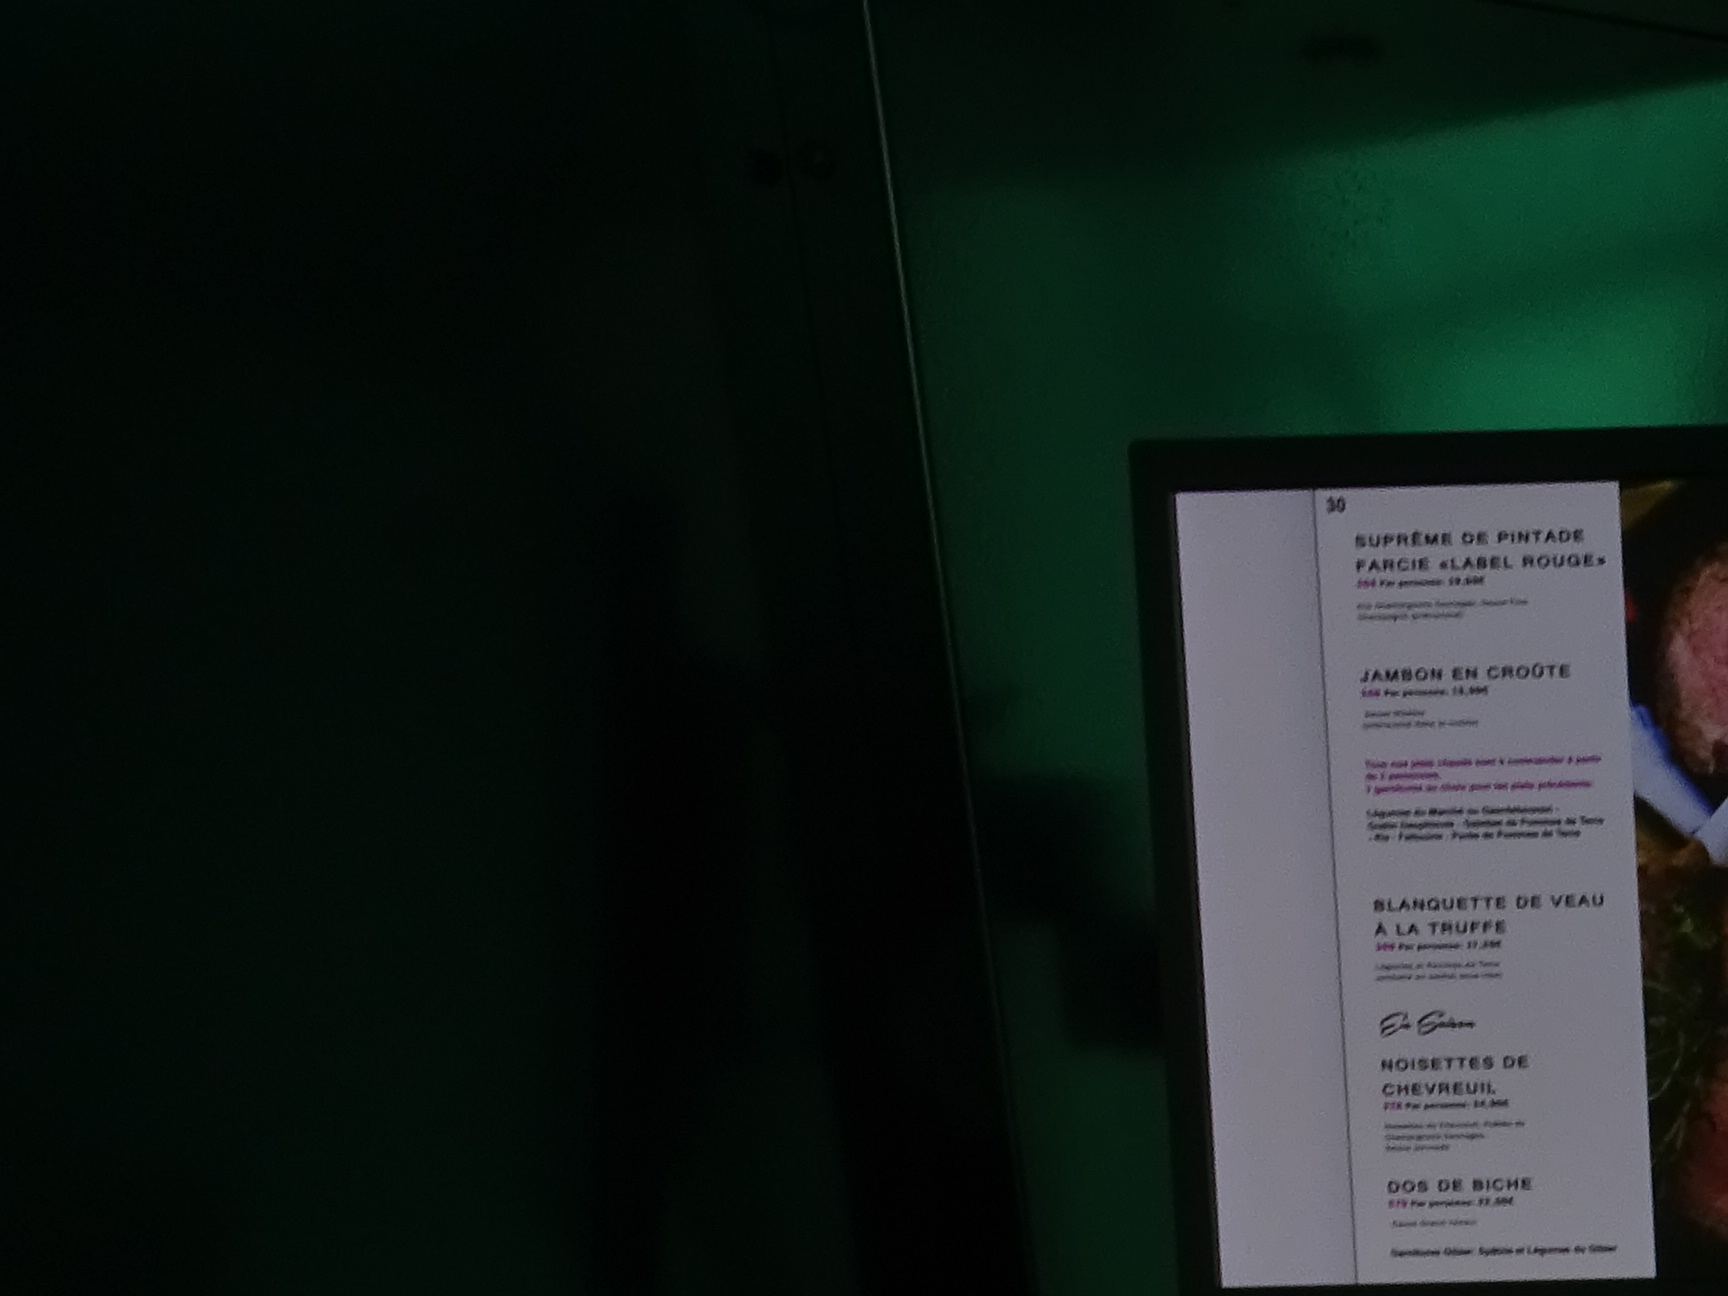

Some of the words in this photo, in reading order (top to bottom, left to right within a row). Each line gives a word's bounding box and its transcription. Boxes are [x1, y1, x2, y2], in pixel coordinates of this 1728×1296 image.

[1355, 529, 1452, 549] SUPRÊME
[1461, 530, 1489, 546] DE
[1497, 528, 1585, 545] PINTADE
[1356, 556, 1430, 573] FARCIE
[1360, 666, 1443, 684] JAMBON
[1452, 666, 1478, 681] EN
[1486, 662, 1571, 681] CROÛTE
[1373, 895, 1507, 913] BLANQUETTE
[1516, 895, 1542, 910] DE
[1551, 893, 1605, 909] VEAU
[1395, 922, 1419, 936] LA
[1428, 919, 1506, 936] TRUFFE
[1380, 1055, 1493, 1072] NOISETTES
[1503, 1055, 1530, 1070] DE
[1382, 1081, 1497, 1098] CHEVREUIL
[1387, 1179, 1428, 1194] DOS
[1437, 1178, 1463, 1193] DE
[1472, 1177, 1534, 1192] BICHE
